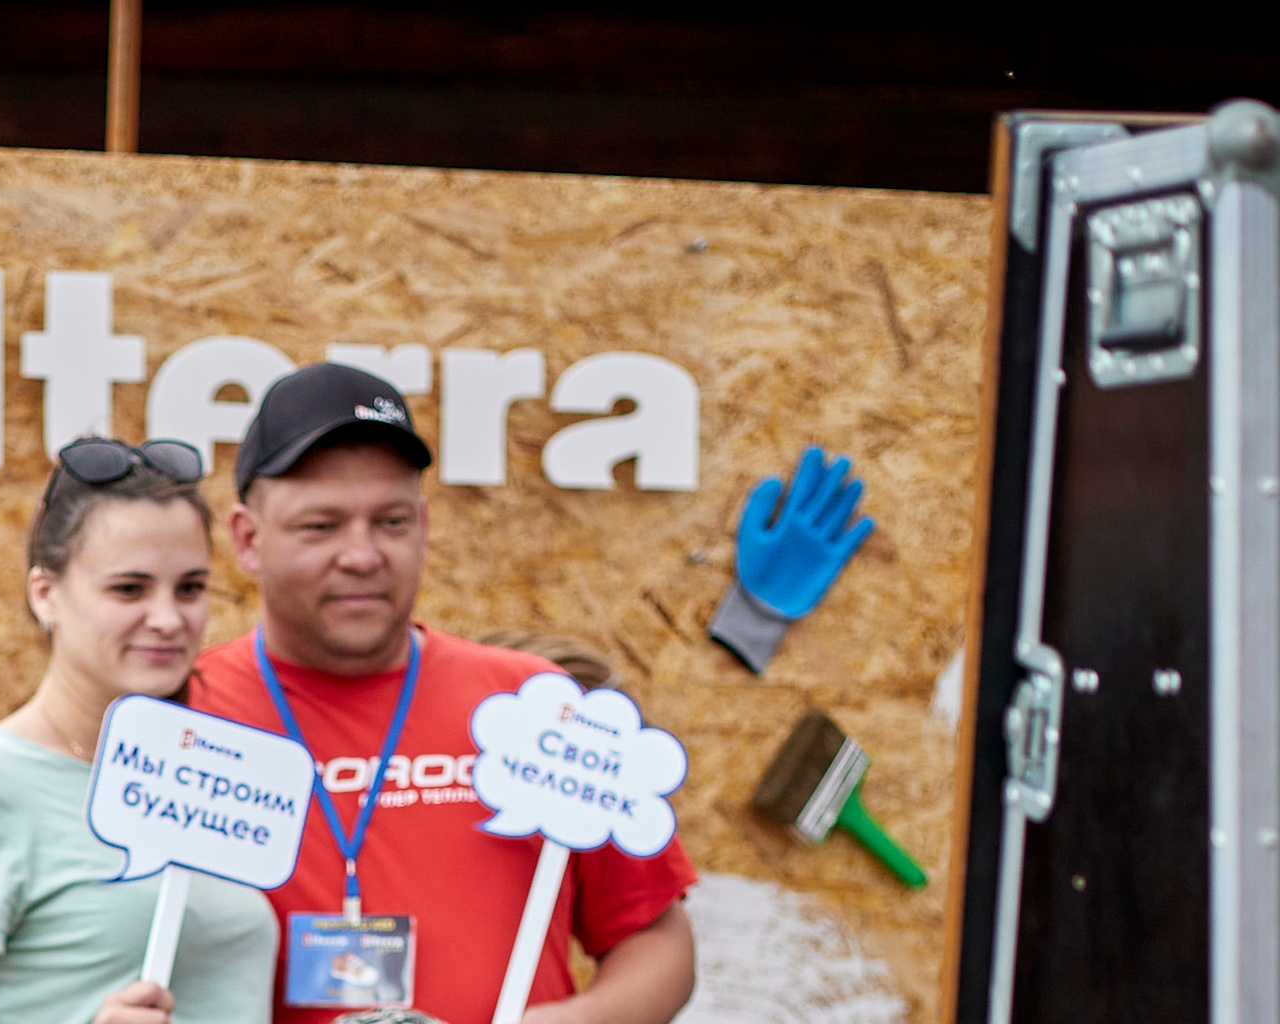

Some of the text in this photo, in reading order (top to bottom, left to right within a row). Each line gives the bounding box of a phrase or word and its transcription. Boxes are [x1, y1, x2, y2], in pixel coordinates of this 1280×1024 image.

[111, 741, 166, 777] Мы
[173, 764, 296, 817] строим
[538, 730, 622, 778] Свой
[122, 781, 271, 846] будущее
[502, 755, 638, 817] человек
